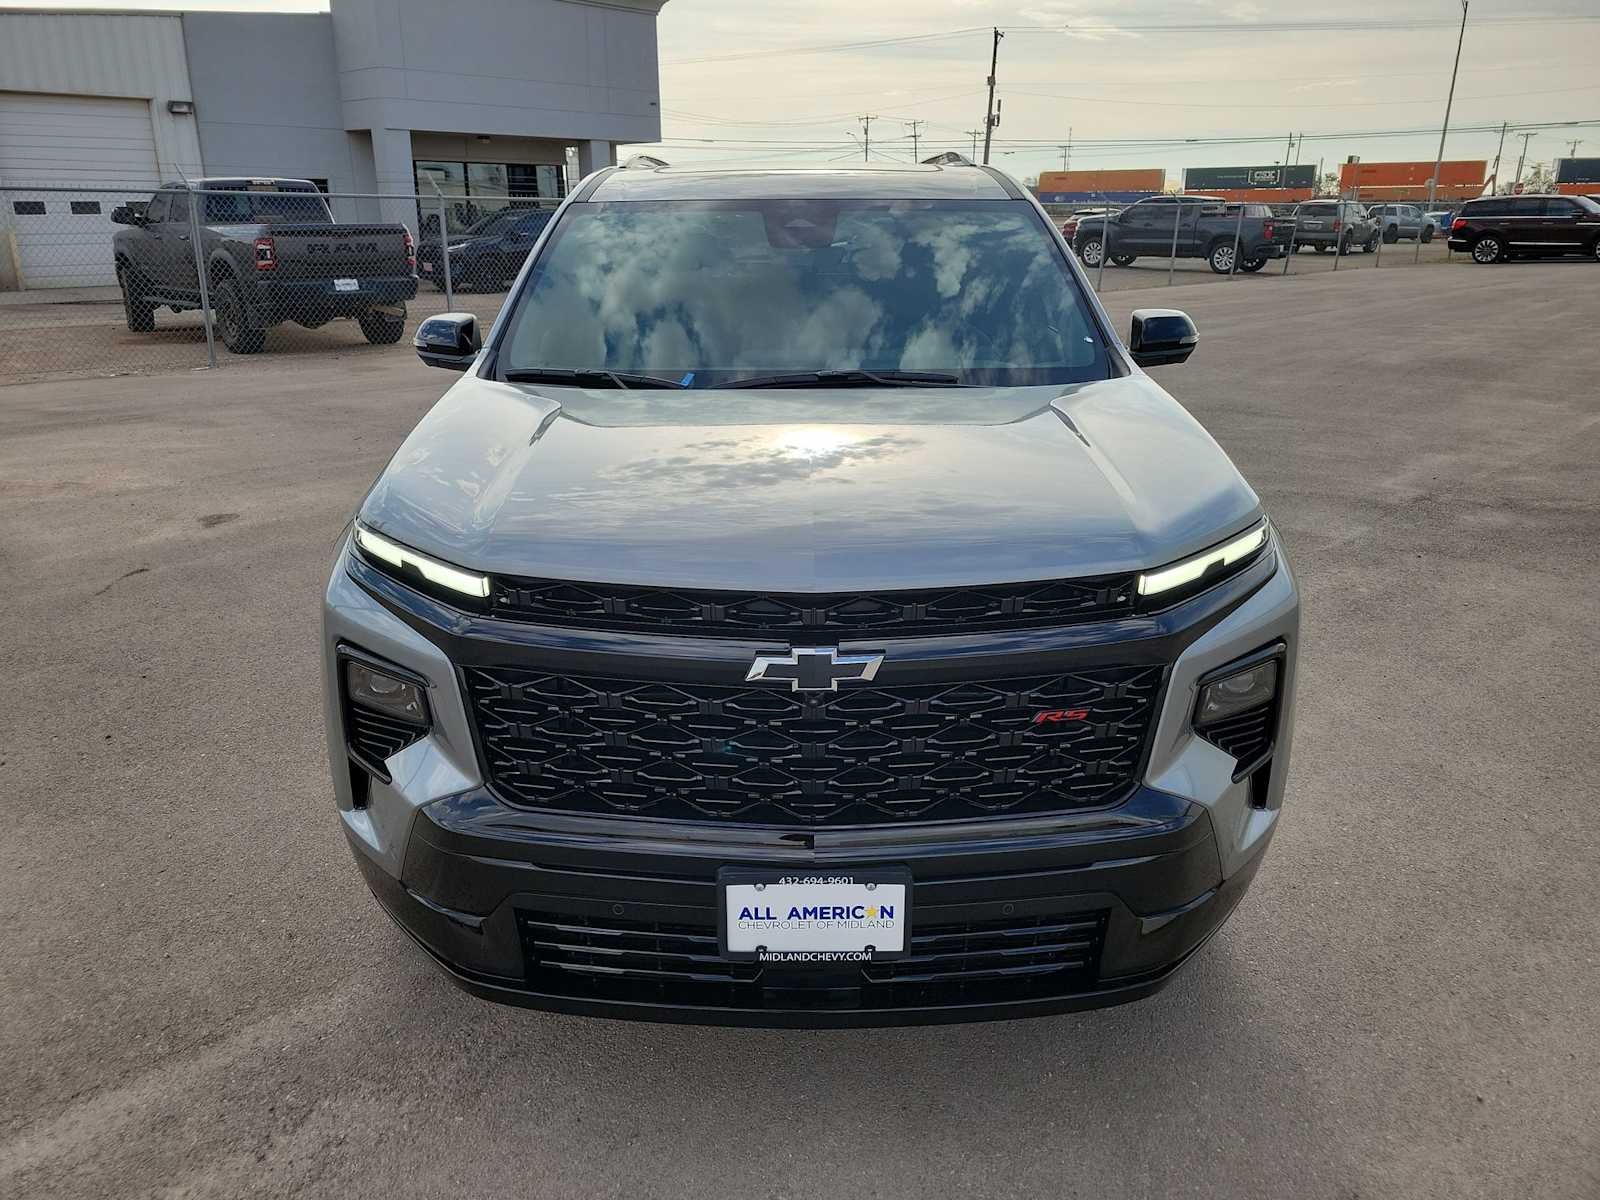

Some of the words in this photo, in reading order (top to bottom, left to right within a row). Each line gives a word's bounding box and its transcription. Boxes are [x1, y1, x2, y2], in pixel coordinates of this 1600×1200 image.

[1032, 708, 1088, 722] RS
[778, 877, 854, 885] 432-694-9601
[739, 907, 777, 920] ALL
[787, 905, 894, 920] AMERICN
[738, 920, 813, 930] CHEVROLET
[815, 920, 834, 930] OF
[837, 920, 895, 929] MIDLAND
[759, 952, 872, 962] MIDLANDCHEVY.COM
